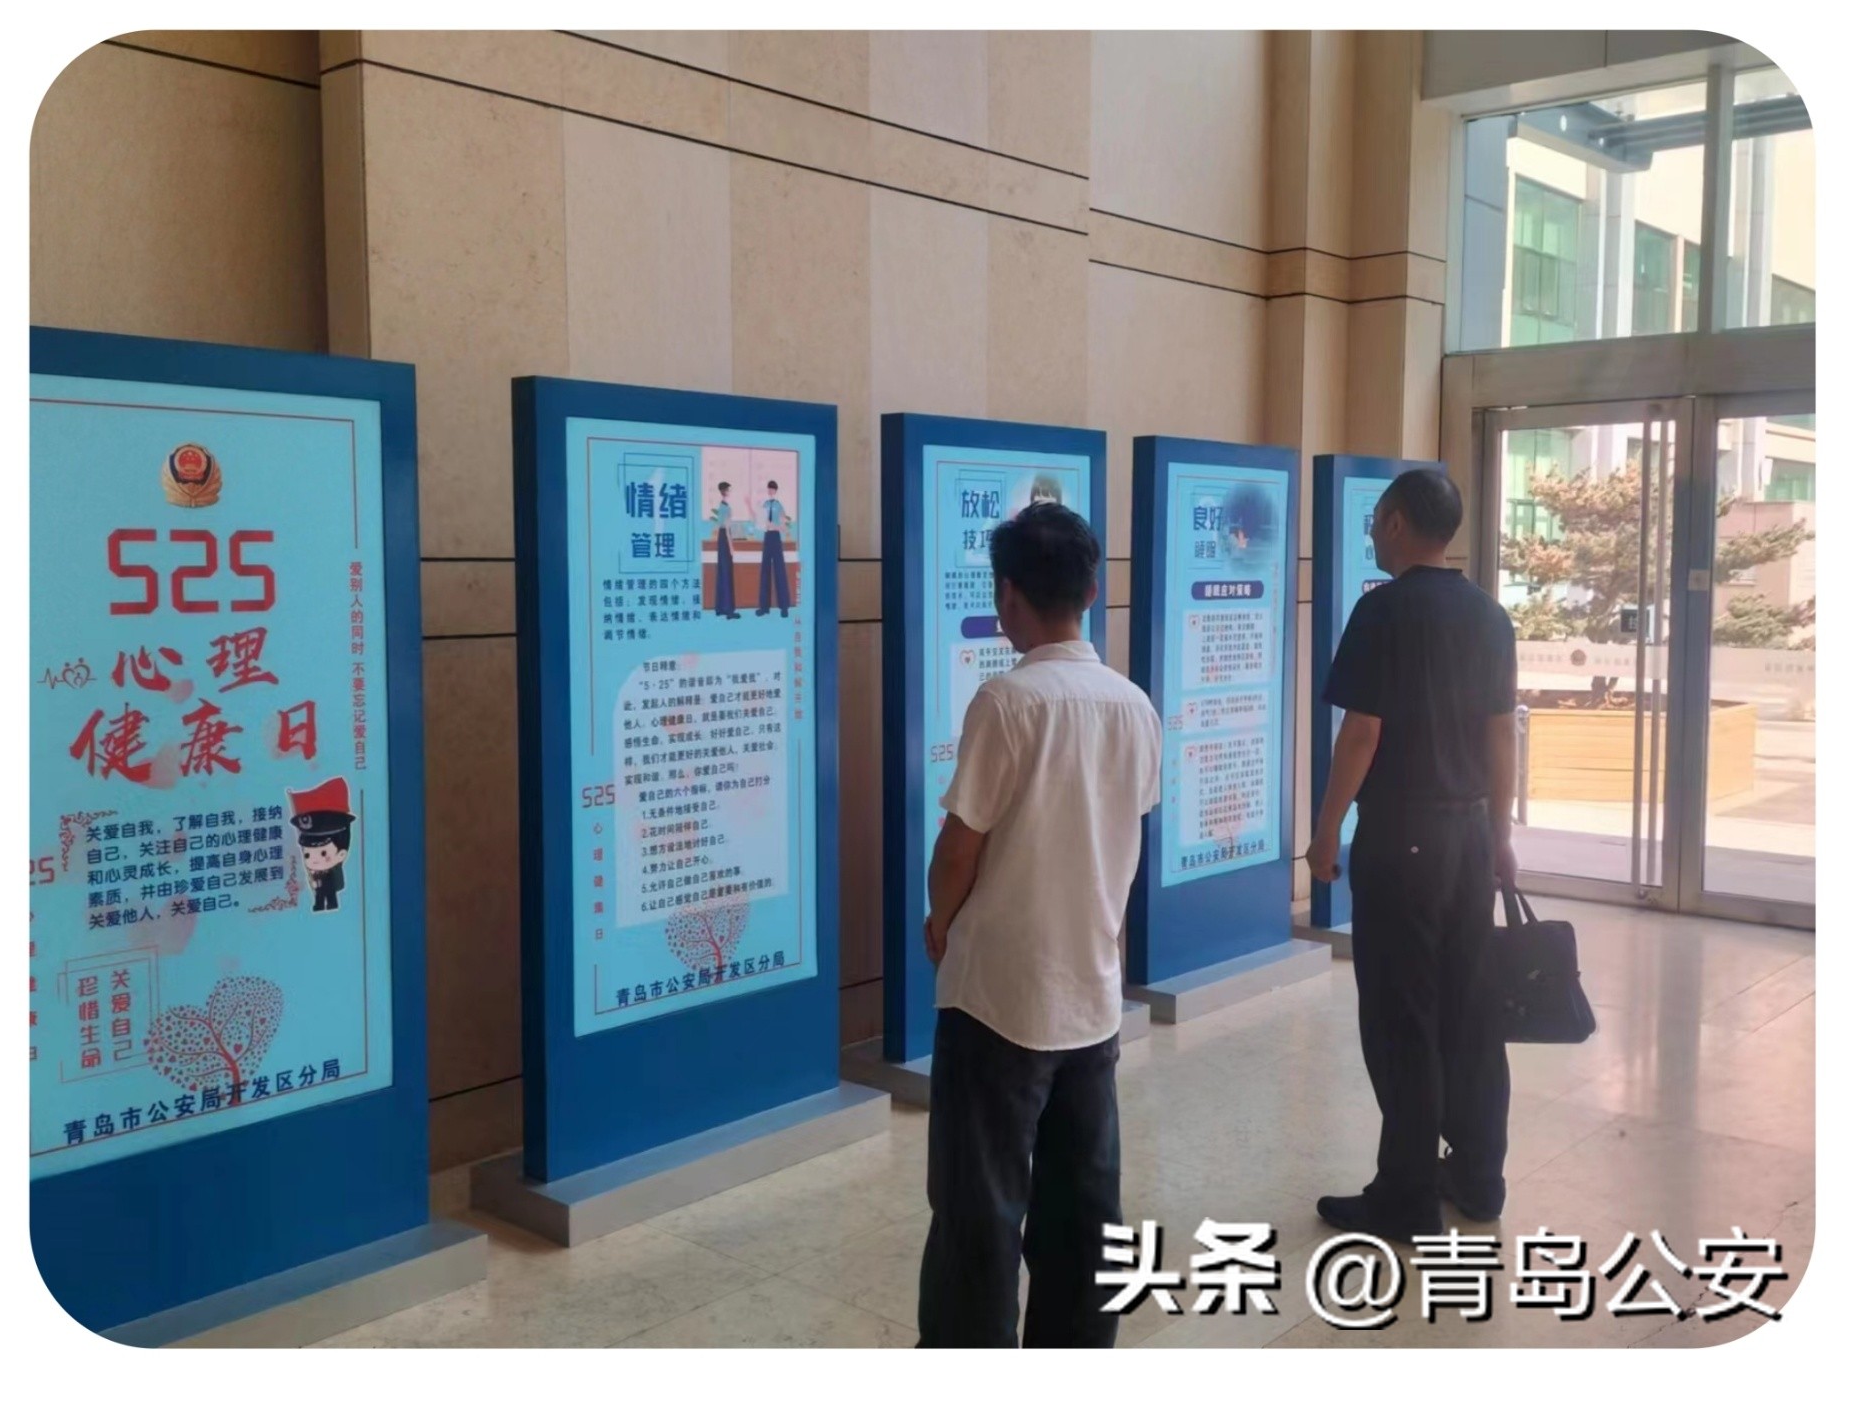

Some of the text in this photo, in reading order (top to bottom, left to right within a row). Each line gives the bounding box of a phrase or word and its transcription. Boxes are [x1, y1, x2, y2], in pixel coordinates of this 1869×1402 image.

[626, 482, 688, 519] 情绪
[961, 489, 1000, 519] 放松
[1193, 506, 1224, 532] 良好
[631, 532, 675, 559] 管理
[107, 528, 276, 615] 525
[111, 627, 279, 692] 心理
[349, 562, 367, 771] 爱别人的同时 不要忘记爱自己
[70, 699, 318, 782] 健康日
[581, 784, 615, 808] 525
[86, 805, 283, 842] 关爱自我，了解自我，接纳
[86, 825, 284, 865] 自己，关注自己的心理健康
[87, 846, 284, 886] 和心灵成长，提高自身心理
[87, 866, 284, 907] 素质，并由珍爱自己发展到
[88, 897, 240, 930] 关爱他人，关爱自己。
[616, 950, 785, 1008] 青岛市公安局开发区分局
[77, 975, 102, 1069] 珍惜生命
[110, 969, 134, 1061] 关爱自己
[63, 1058, 343, 1145] 青岛市公安局开发区分局
